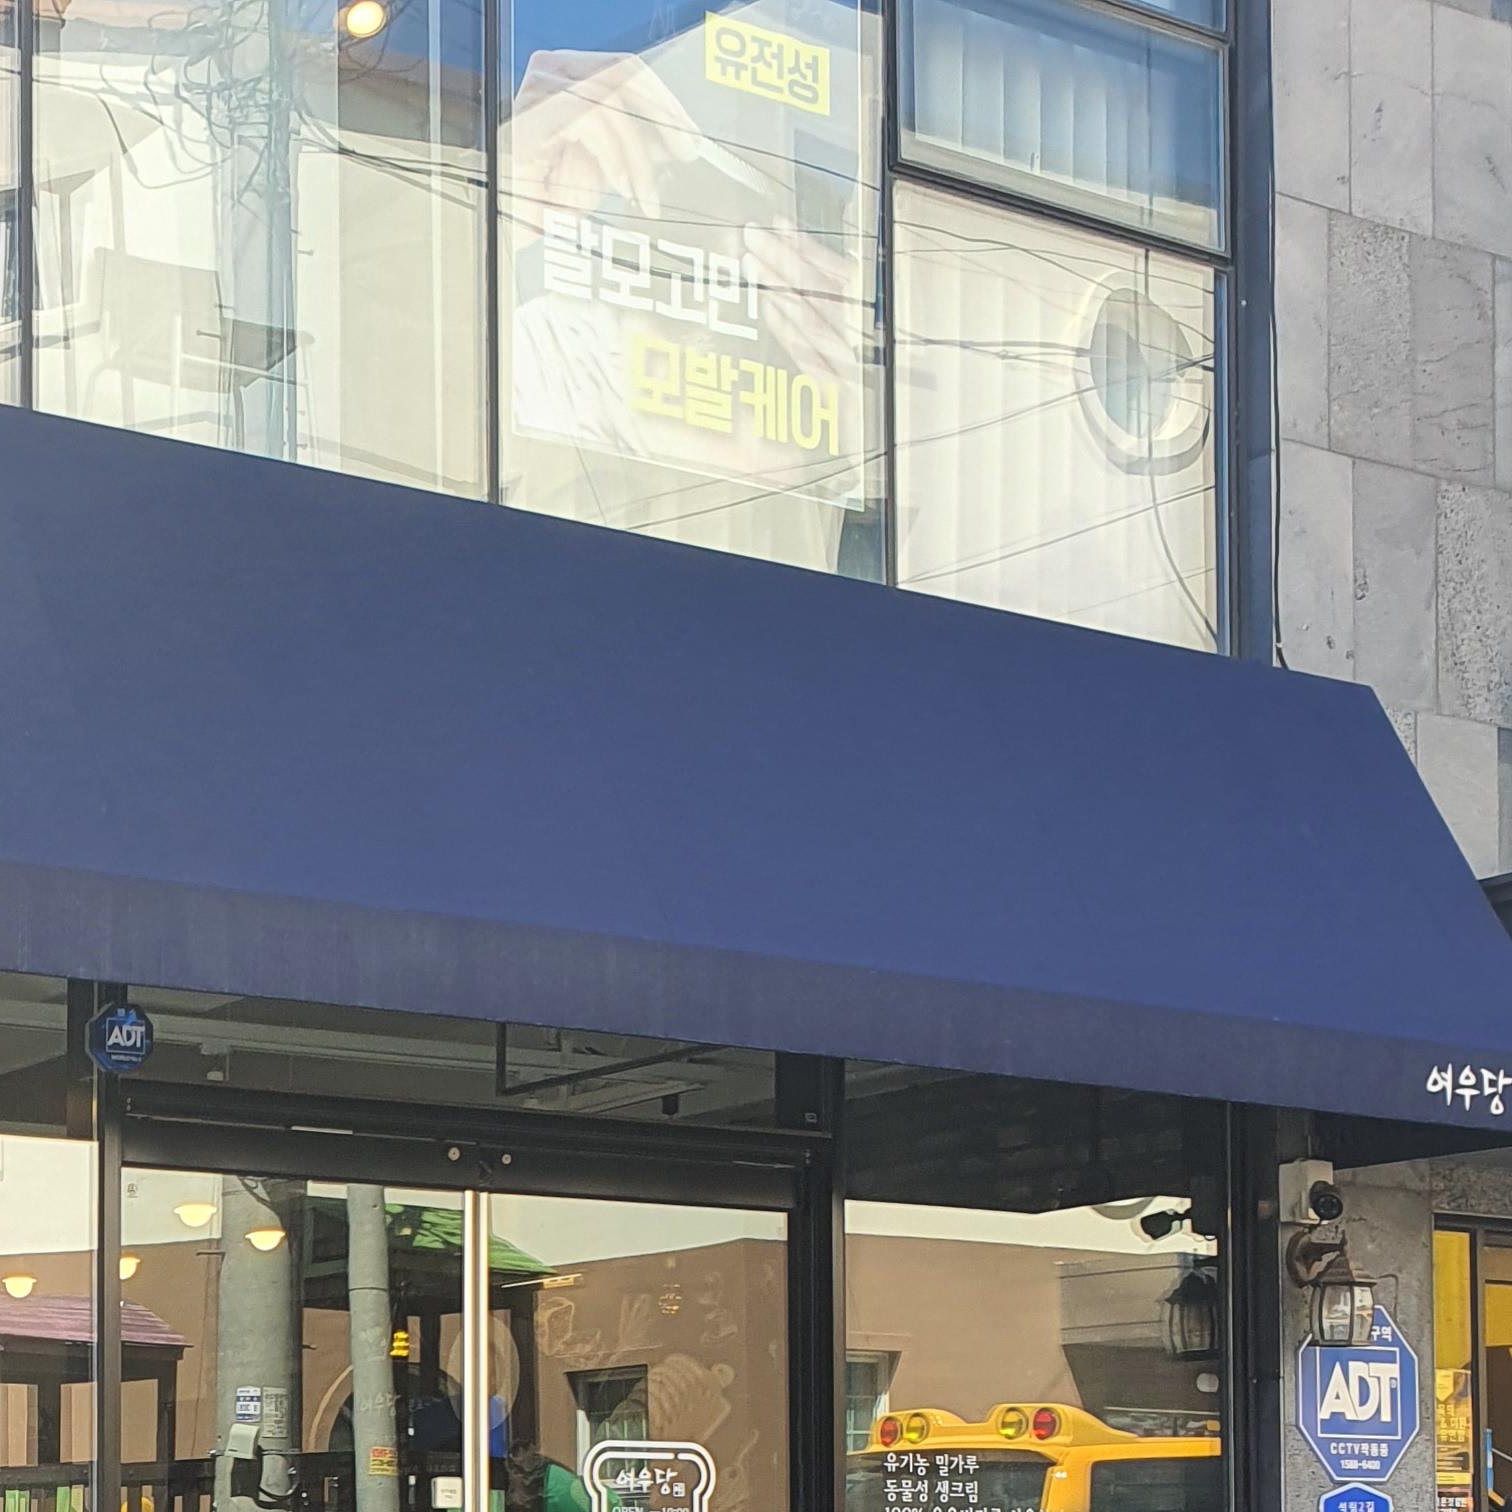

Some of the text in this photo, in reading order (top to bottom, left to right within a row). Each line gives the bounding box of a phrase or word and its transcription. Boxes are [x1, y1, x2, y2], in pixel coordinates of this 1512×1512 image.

[713, 26, 821, 106] 유전성
[543, 209, 759, 341] 탈모고민
[630, 333, 840, 457] 모발케어
[108, 1025, 145, 1047] ADT
[1425, 1062, 1512, 1116] 여우당
[1370, 1325, 1392, 1342] 구역
[1319, 1360, 1399, 1422] ADT
[615, 1467, 679, 1495] 여우당
[883, 1452, 980, 1477] 유기농 밀가루
[883, 1479, 978, 1503] 동물성 생크림
